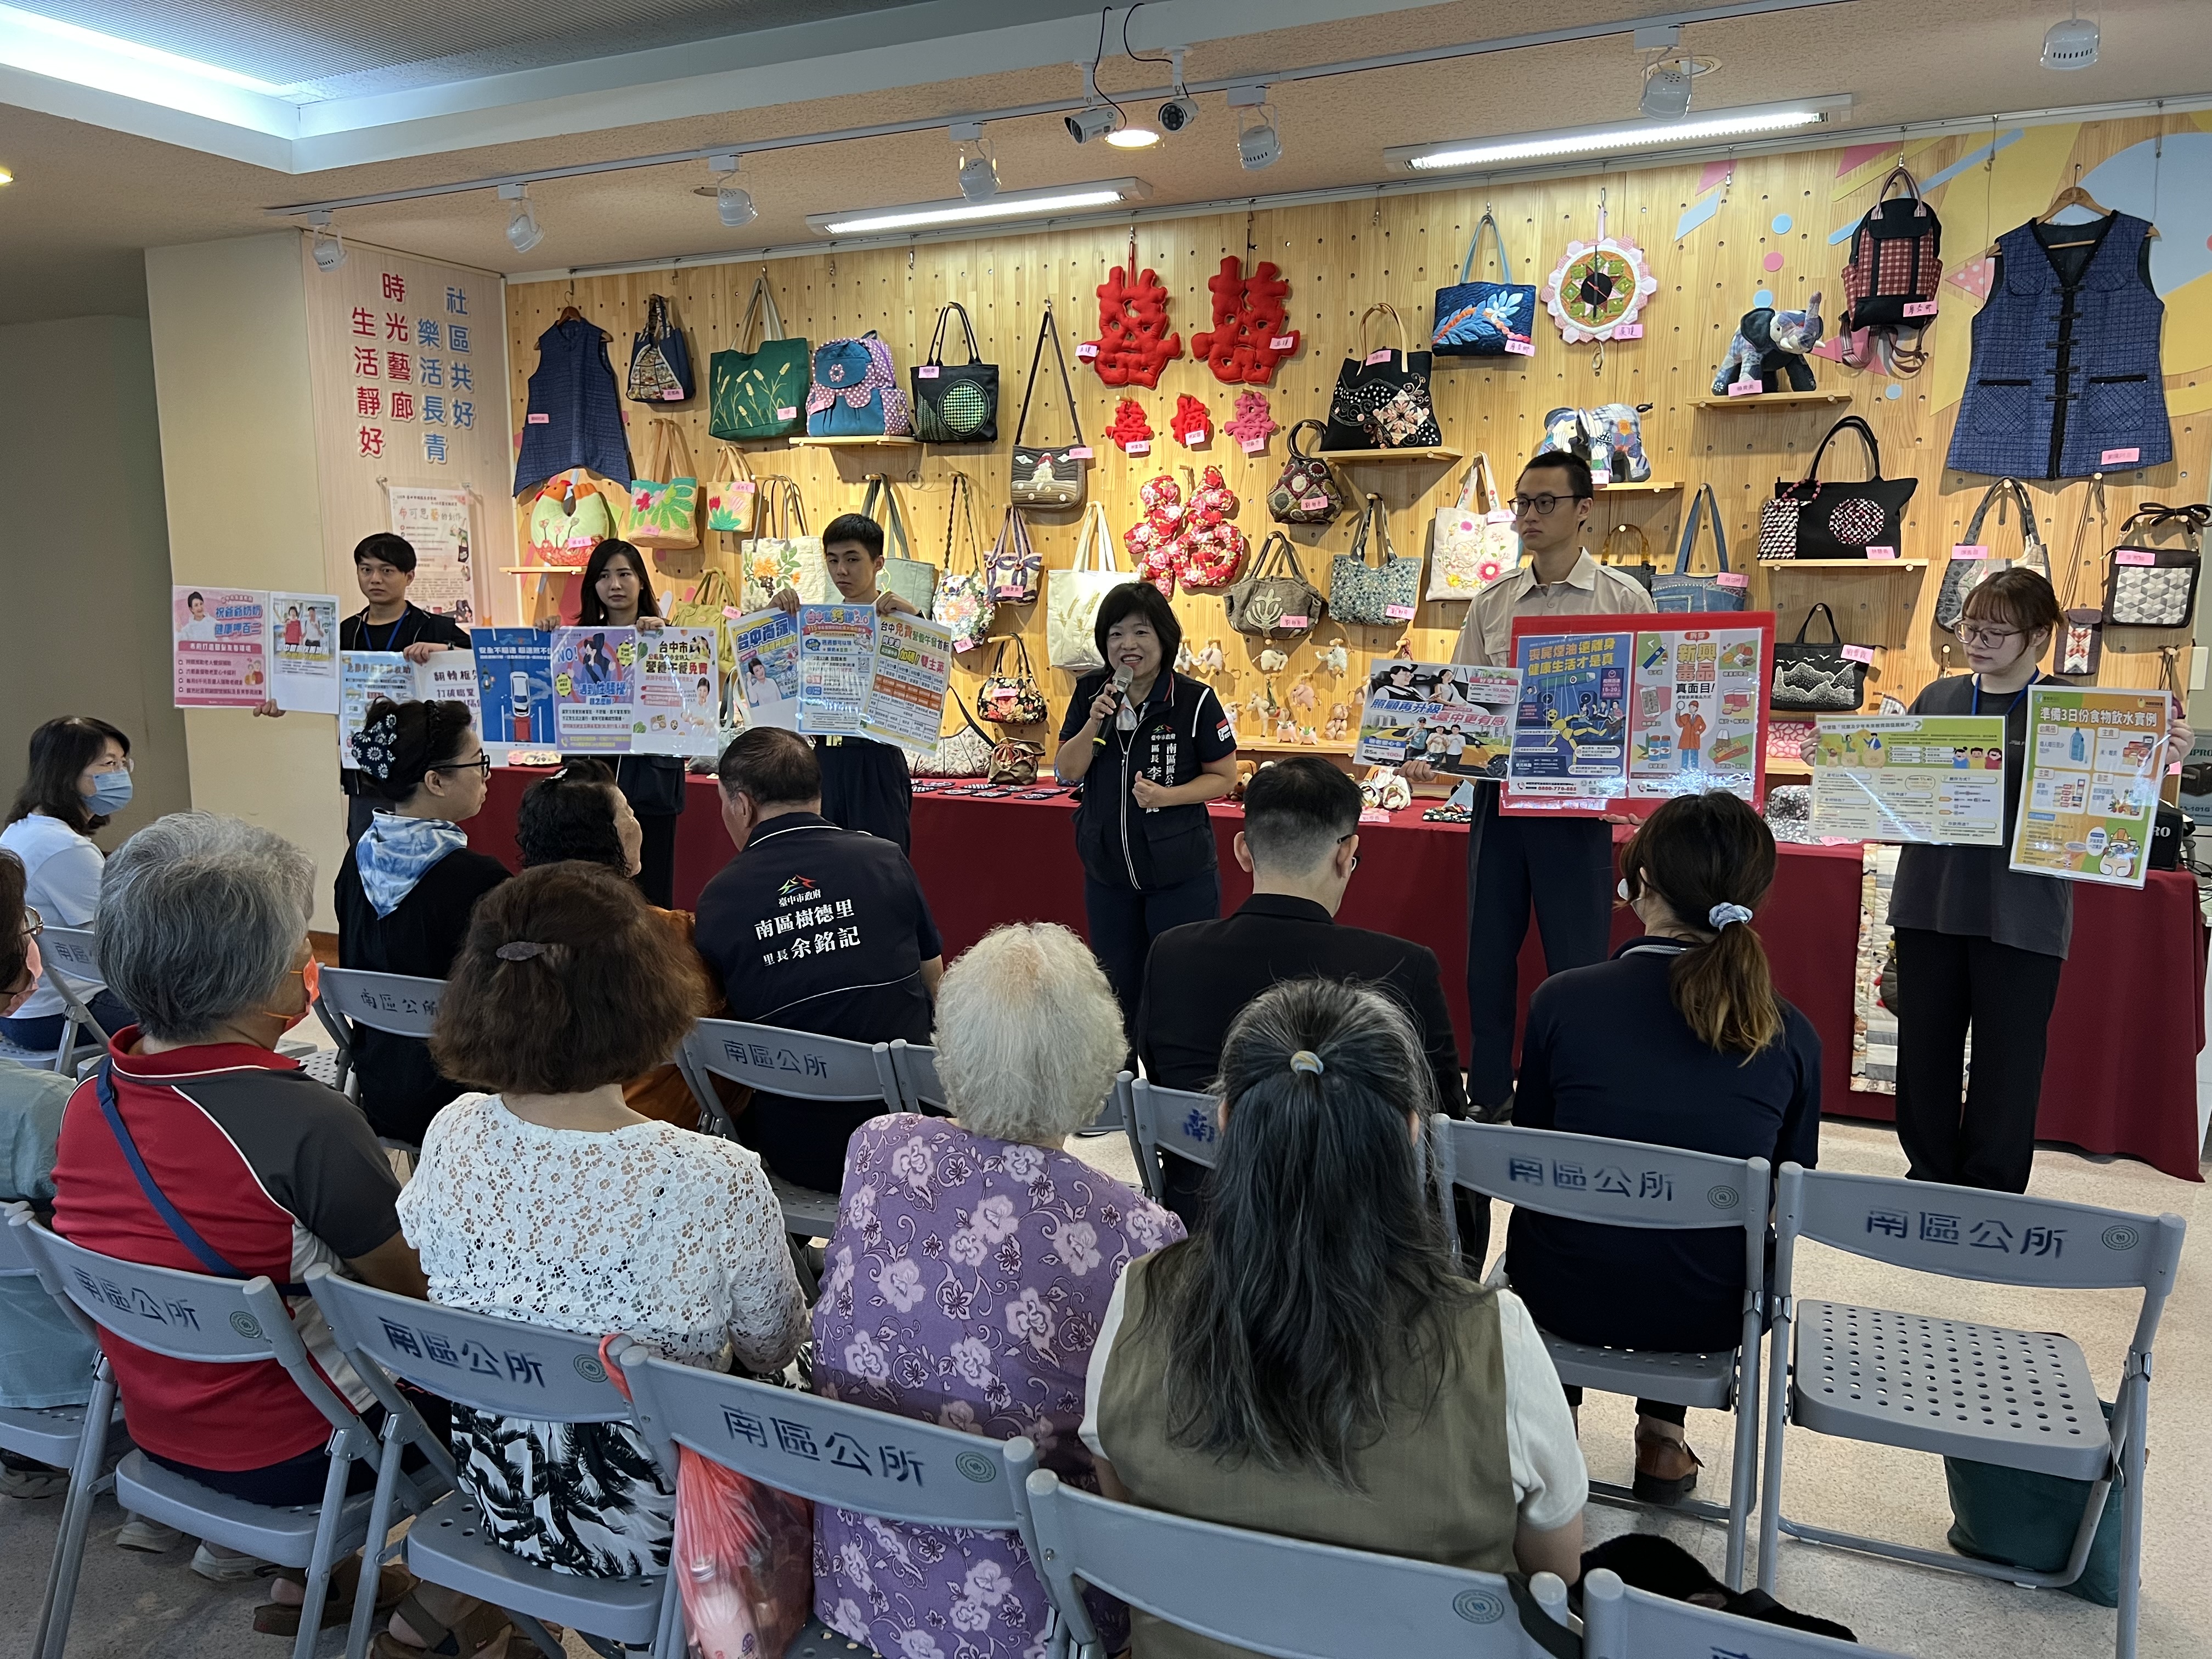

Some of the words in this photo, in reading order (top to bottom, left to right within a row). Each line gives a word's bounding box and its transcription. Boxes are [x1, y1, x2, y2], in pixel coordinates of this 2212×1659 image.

[382, 273, 414, 420] 時光藝廊
[447, 287, 474, 427] 社區共好
[352, 307, 383, 455] 生活靜好
[417, 318, 445, 461] 樂活長青
[558, 646, 578, 662] NO!
[659, 641, 688, 653] 台中市
[1528, 637, 1616, 662] 喪屍煙油遠離身
[1677, 643, 1717, 662] 新興
[921, 655, 945, 675] 雙主菜
[1527, 653, 1615, 677] 健康生活才是真
[1677, 662, 1716, 682] 毒品
[1676, 683, 1716, 694] 真面目!
[1370, 698, 1443, 714] 照顧再升級
[1435, 711, 1506, 726] 臺中更有感
[2040, 707, 2157, 727] 準備3日份食物飲水實例
[1147, 744, 1162, 780] 區長李
[778, 889, 821, 907] 臺中市政府
[754, 899, 855, 940] 南區樹德里
[763, 926, 861, 967] 里長余銘記
[360, 988, 438, 1015] 南區公所
[722, 1039, 827, 1079] 南區公所
[1509, 1156, 1675, 1201] 南區公所
[1867, 1209, 2069, 1259] 南區公所
[70, 1265, 200, 1331] 南區公所
[378, 1317, 546, 1389] 南區公所
[720, 1404, 924, 1488] 南區公所
